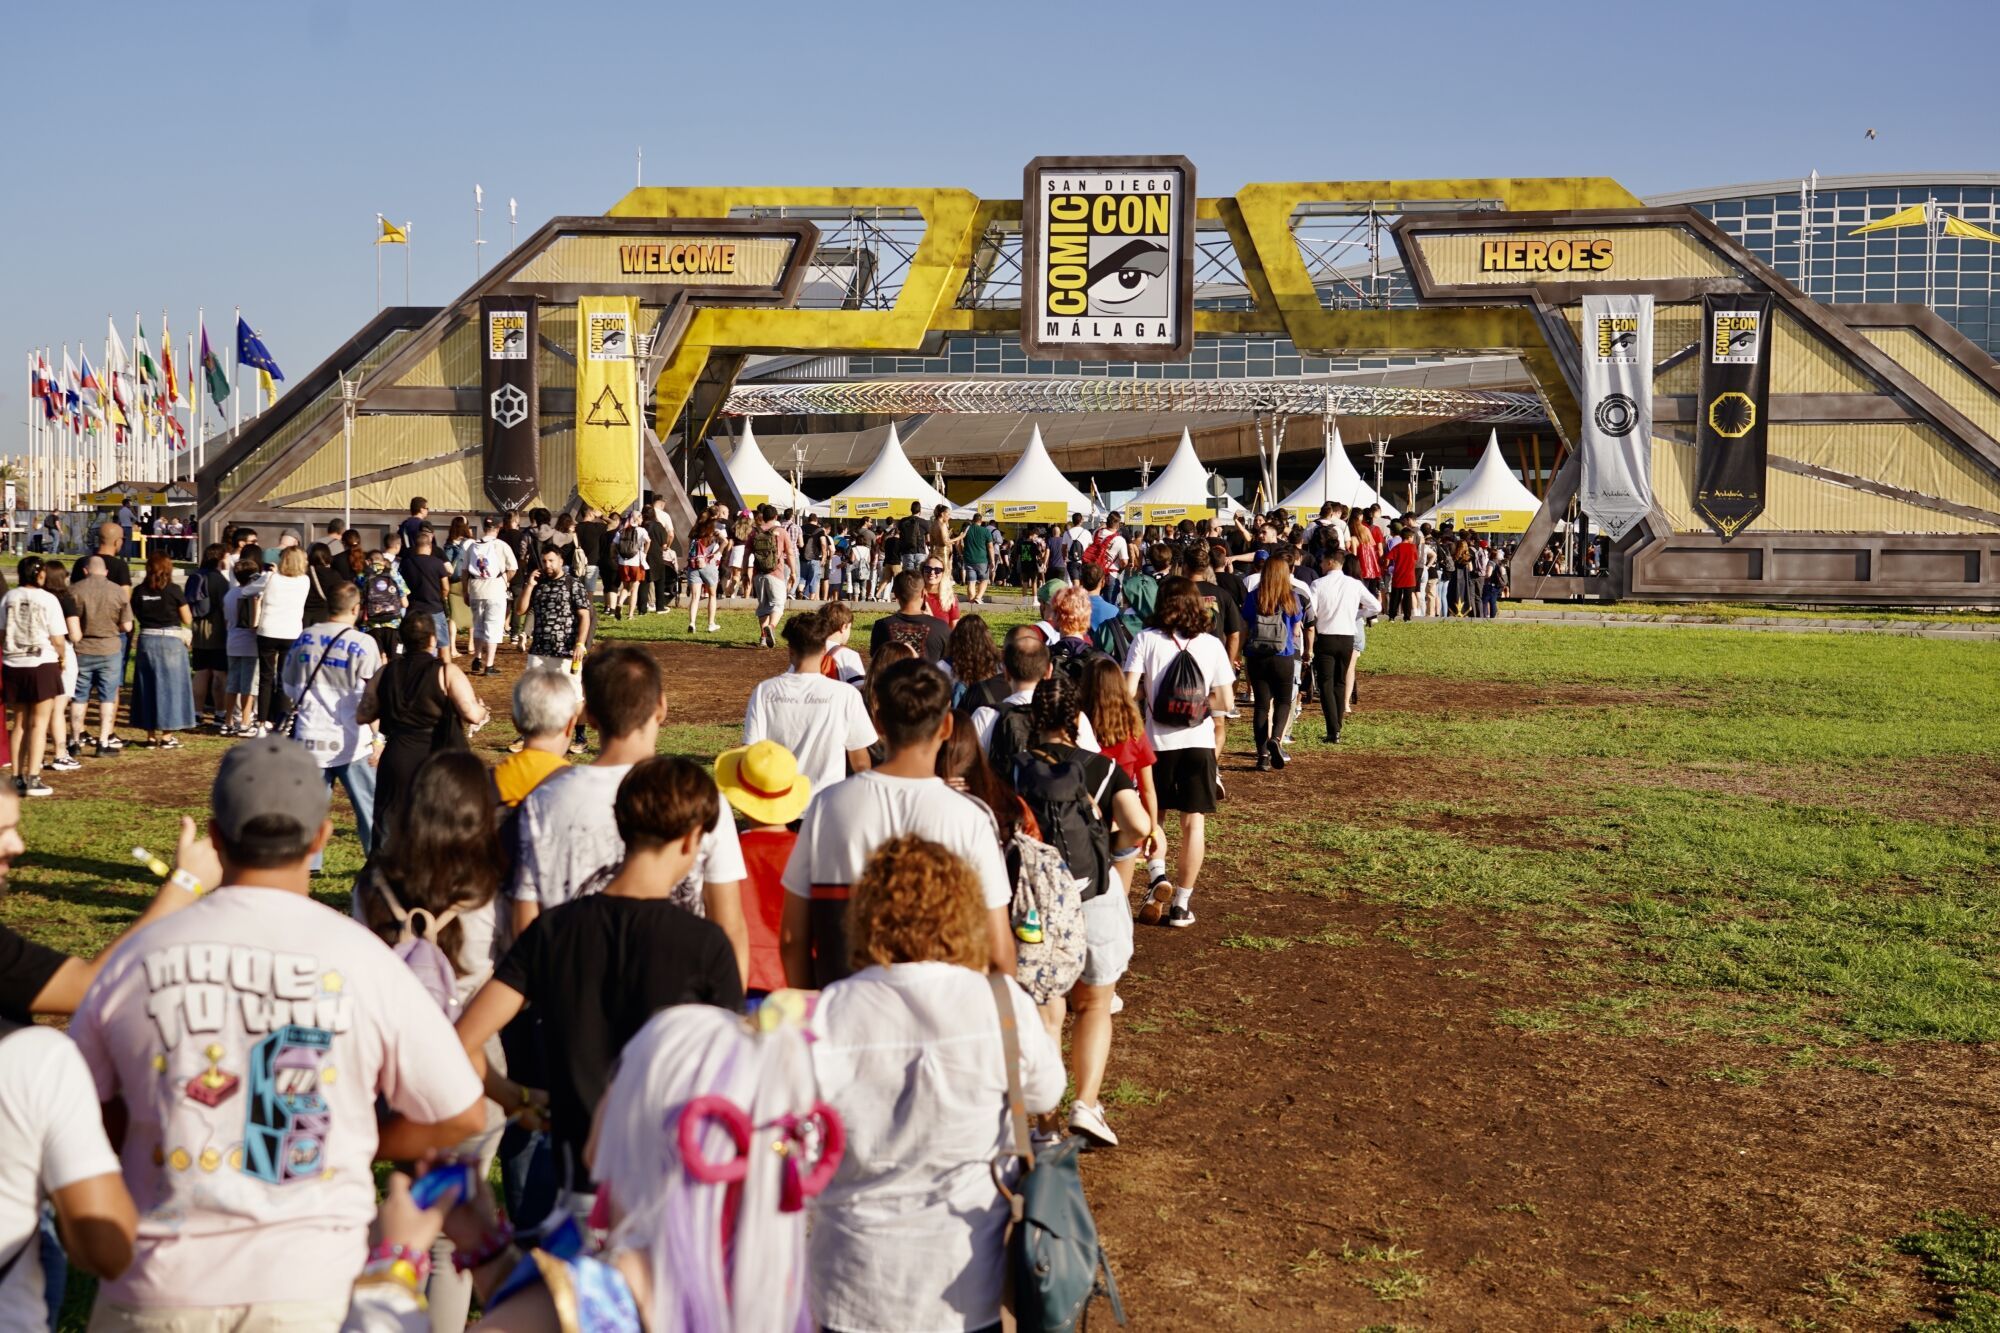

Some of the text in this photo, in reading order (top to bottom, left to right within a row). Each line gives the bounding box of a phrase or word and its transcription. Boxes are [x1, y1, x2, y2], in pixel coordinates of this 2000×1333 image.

[1048, 179, 1171, 191] SAN DIEGO
[1092, 194, 1169, 235] CON
[620, 244, 735, 274] WELCOME
[1048, 195, 1090, 315] COMIC
[1482, 239, 1614, 272] HEROES
[492, 317, 504, 352] COMIC
[504, 317, 524, 329] CON
[591, 318, 603, 353] COMIC
[603, 319, 625, 330] CON
[1047, 318, 1167, 337] MÁLAGA
[1599, 319, 1611, 356] COMIC
[1612, 319, 1637, 331] CON
[1716, 317, 1730, 355] COMIC
[1730, 318, 1756, 331] CON
[143, 942, 318, 1001] MADE
[147, 984, 353, 1051] TO WIN
